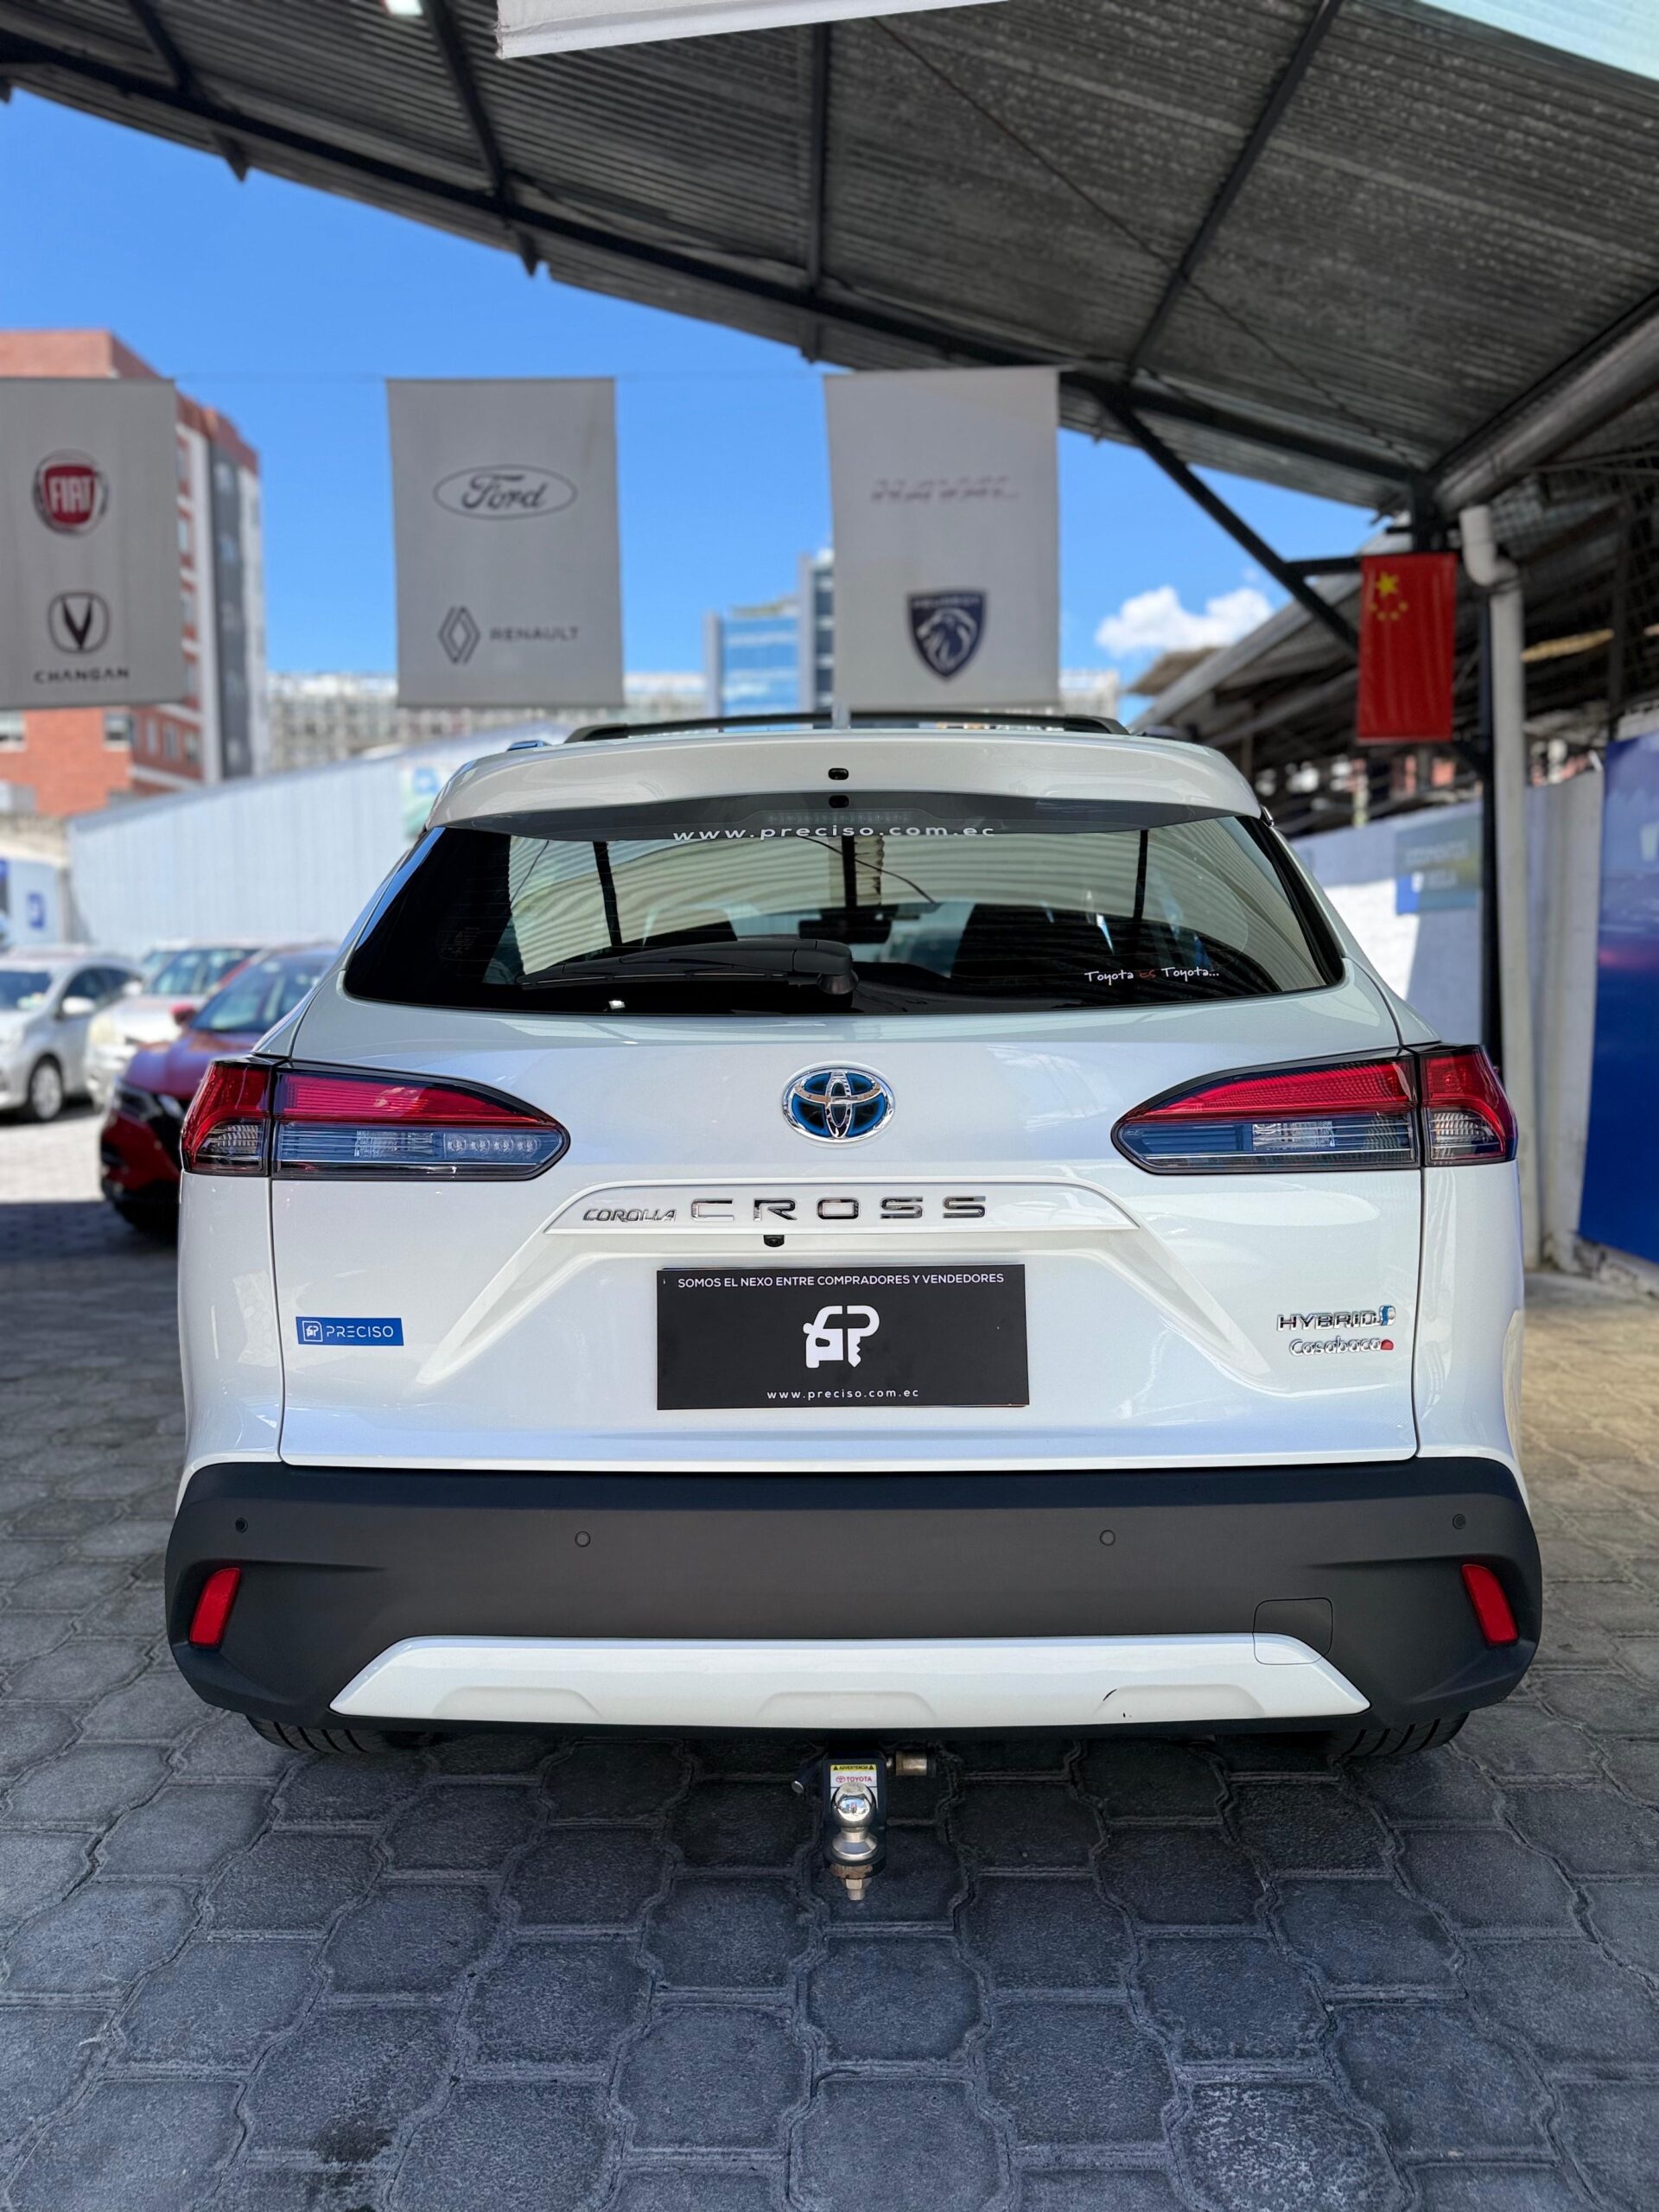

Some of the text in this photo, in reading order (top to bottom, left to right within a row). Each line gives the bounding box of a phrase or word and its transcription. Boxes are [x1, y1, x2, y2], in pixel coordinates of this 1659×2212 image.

[49, 476, 92, 512] FIAT
[462, 474, 547, 510] Ford
[490, 626, 579, 641] RENAULT
[34, 667, 130, 683] CHANGAN
[673, 823, 995, 842] www.preciso.com.ec
[1084, 969, 1134, 986] Toyota
[583, 1196, 987, 1223] COROLLA CROSS
[677, 1273, 1004, 1288] SOMOS EL NEXO ENTRE COMPRADORES Y VENDEDORES
[1277, 1310, 1381, 1332] HYBRID
[326, 1325, 394, 1338] PRECISO
[1289, 1336, 1381, 1357] Casabaca
[766, 1388, 919, 1402] www.preciso.com.ec
